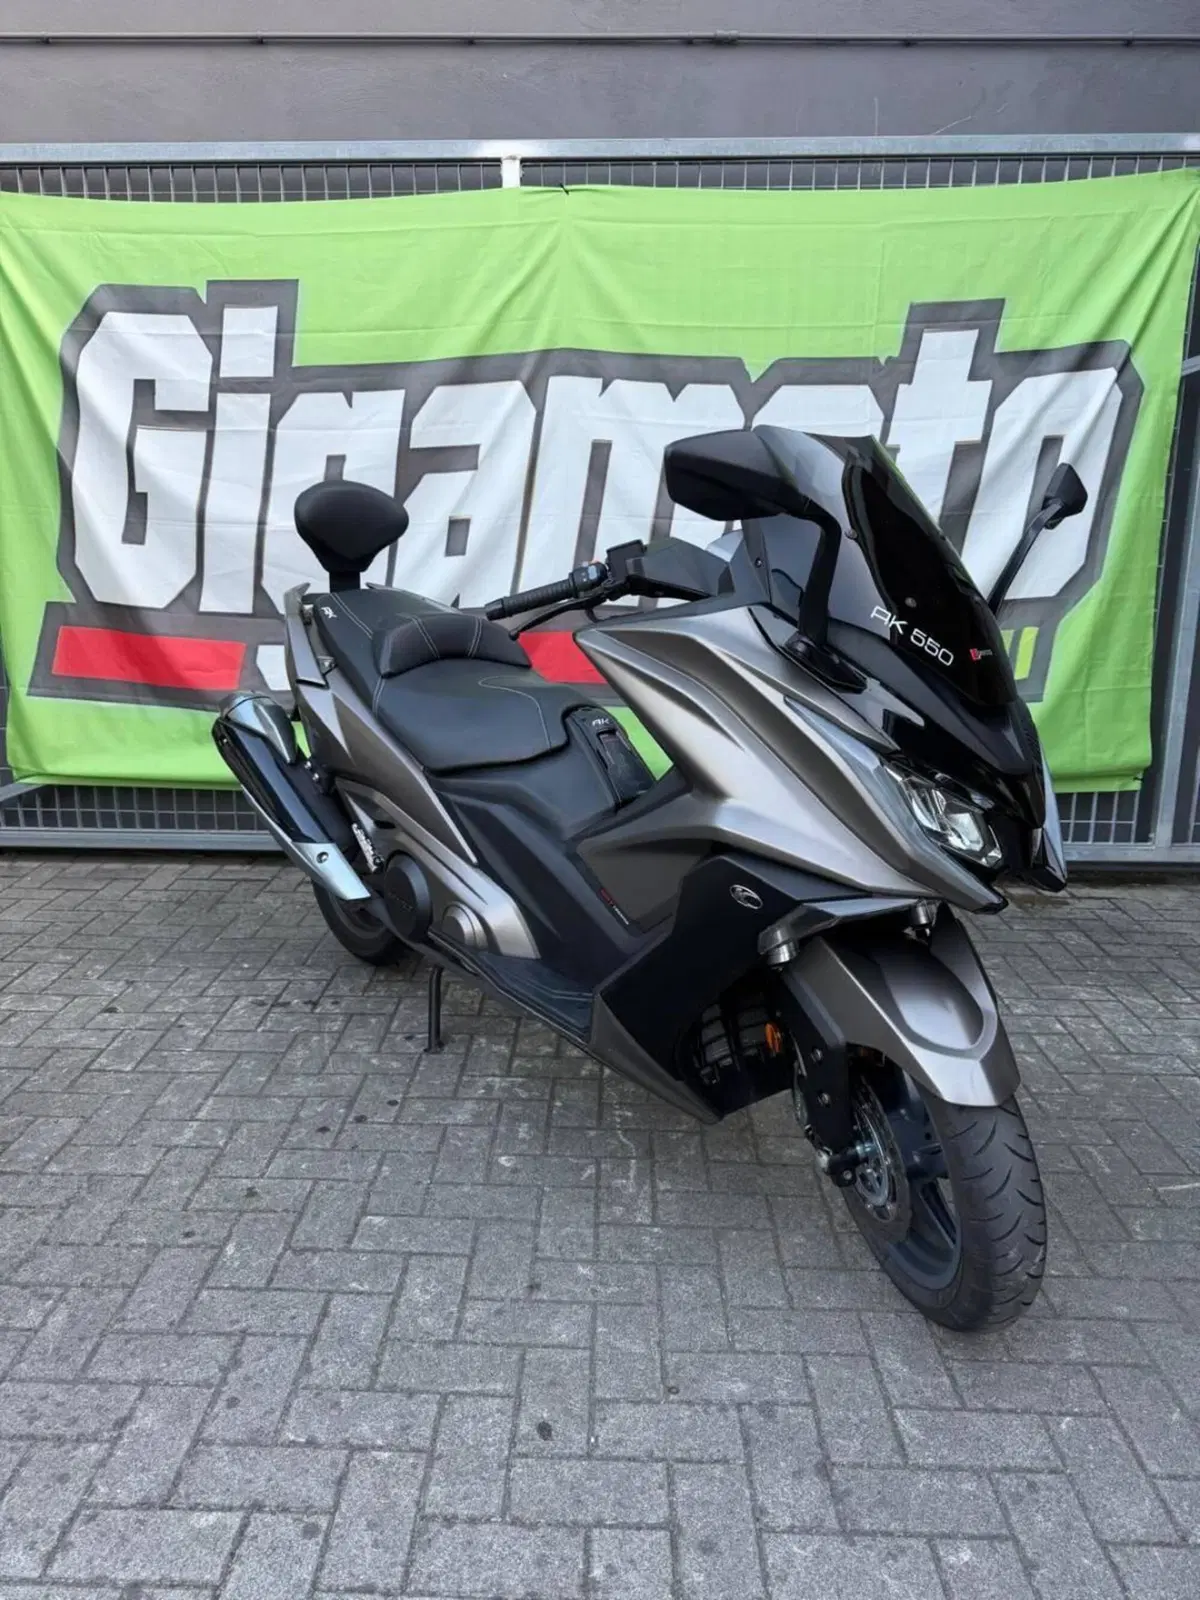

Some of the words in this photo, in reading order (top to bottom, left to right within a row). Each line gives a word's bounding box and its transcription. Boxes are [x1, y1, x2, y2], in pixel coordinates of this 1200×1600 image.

[72, 304, 1124, 692] Gigamto
[870, 605, 908, 635] AK
[910, 628, 955, 667] 550
